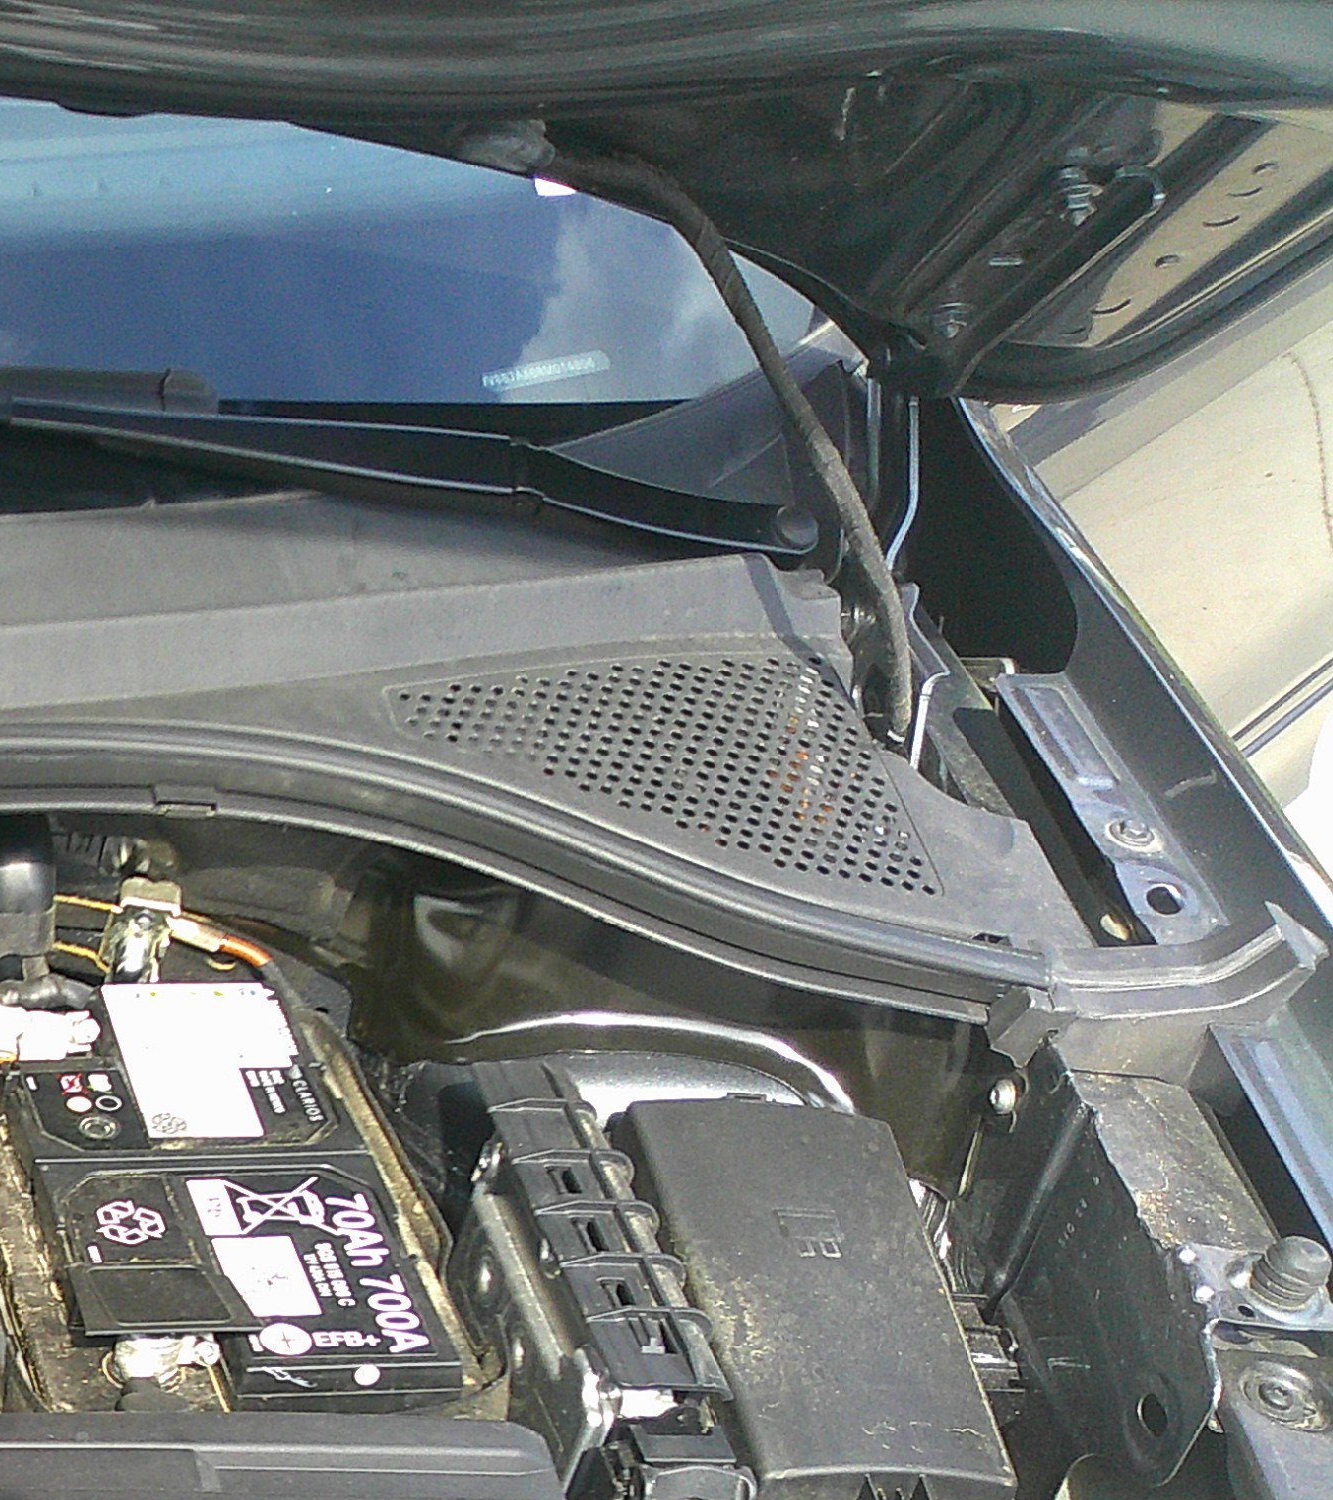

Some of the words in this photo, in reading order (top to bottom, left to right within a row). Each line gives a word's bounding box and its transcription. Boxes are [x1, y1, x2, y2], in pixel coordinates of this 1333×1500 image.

[292, 1080, 324, 1122] CLARIOS
[325, 1193, 390, 1267] 70Ah
[359, 1274, 430, 1353] 700A
[311, 1330, 382, 1347] EFB+
